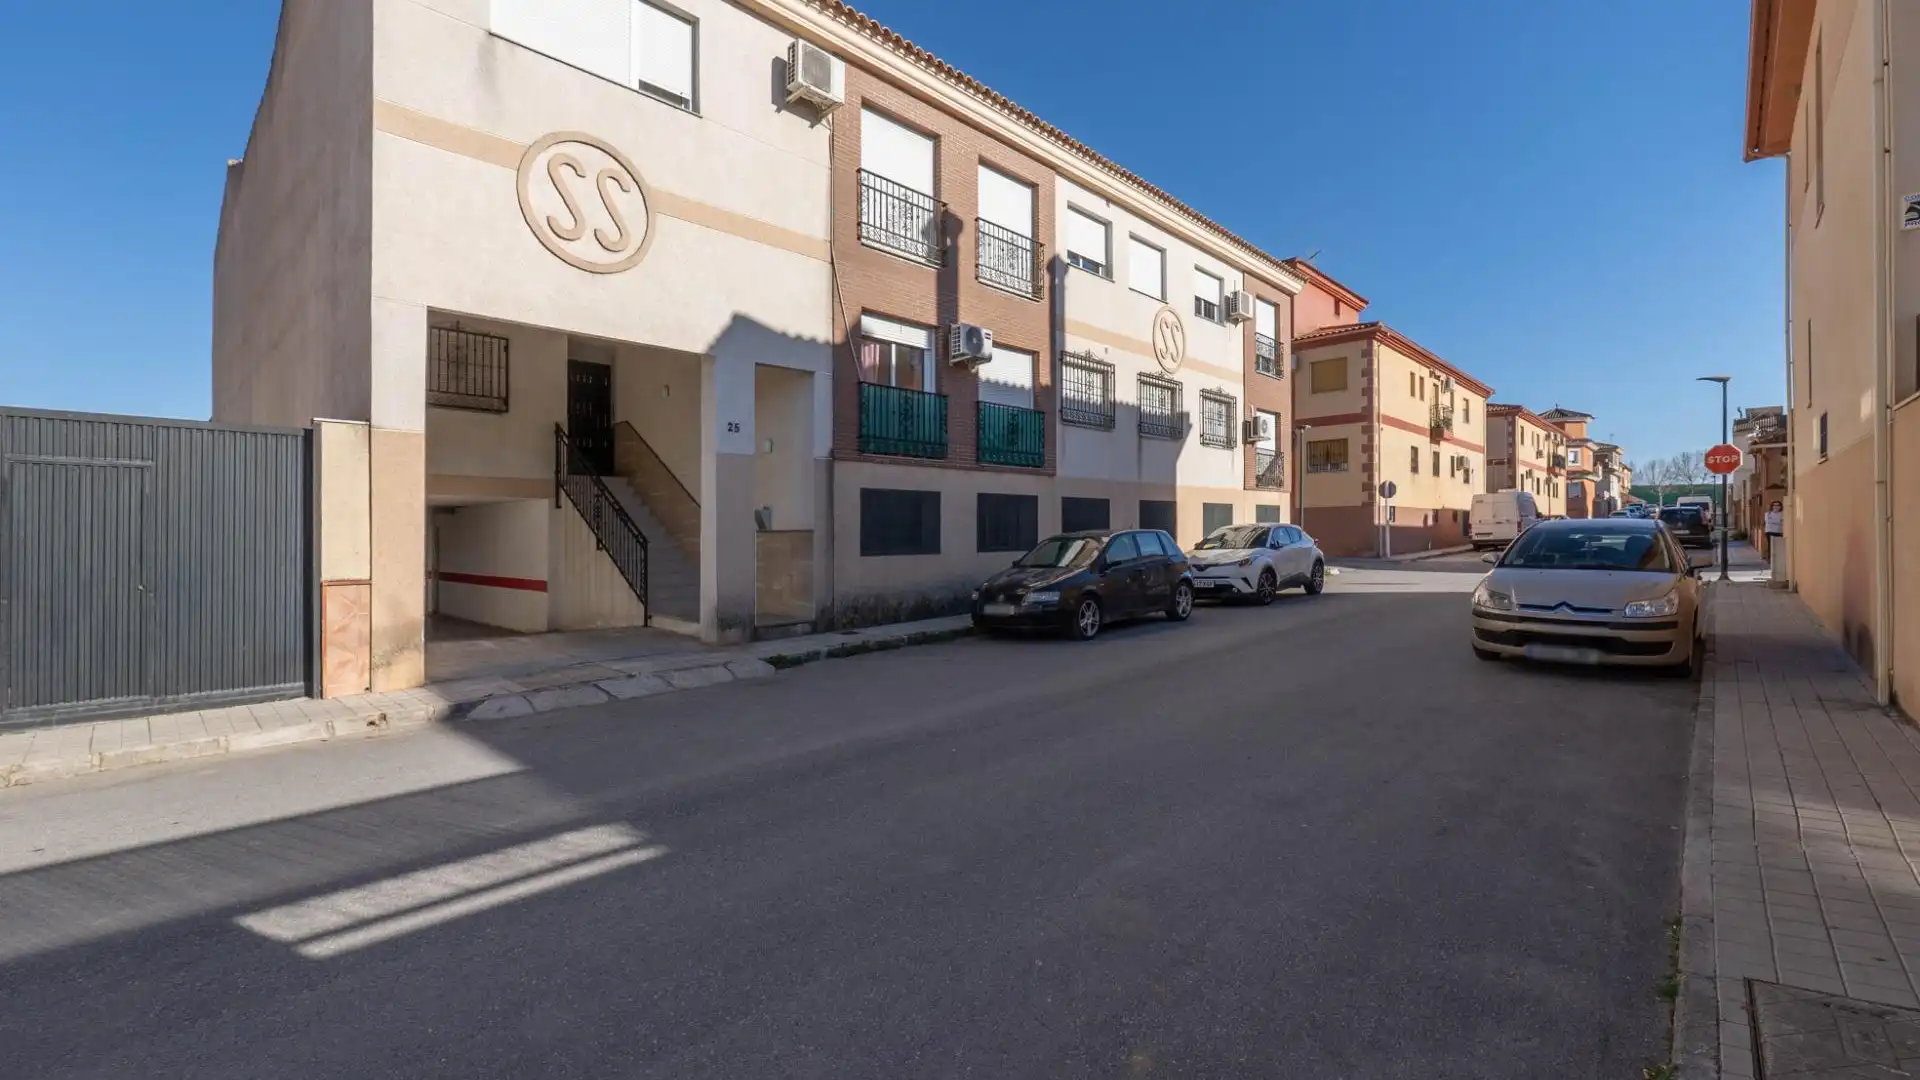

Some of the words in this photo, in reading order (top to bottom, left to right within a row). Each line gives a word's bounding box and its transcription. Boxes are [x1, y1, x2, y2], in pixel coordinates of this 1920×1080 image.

[547, 153, 631, 253] SS
[1159, 316, 1180, 363] SS
[727, 421, 741, 433] 25
[1707, 455, 1738, 464] STOP
